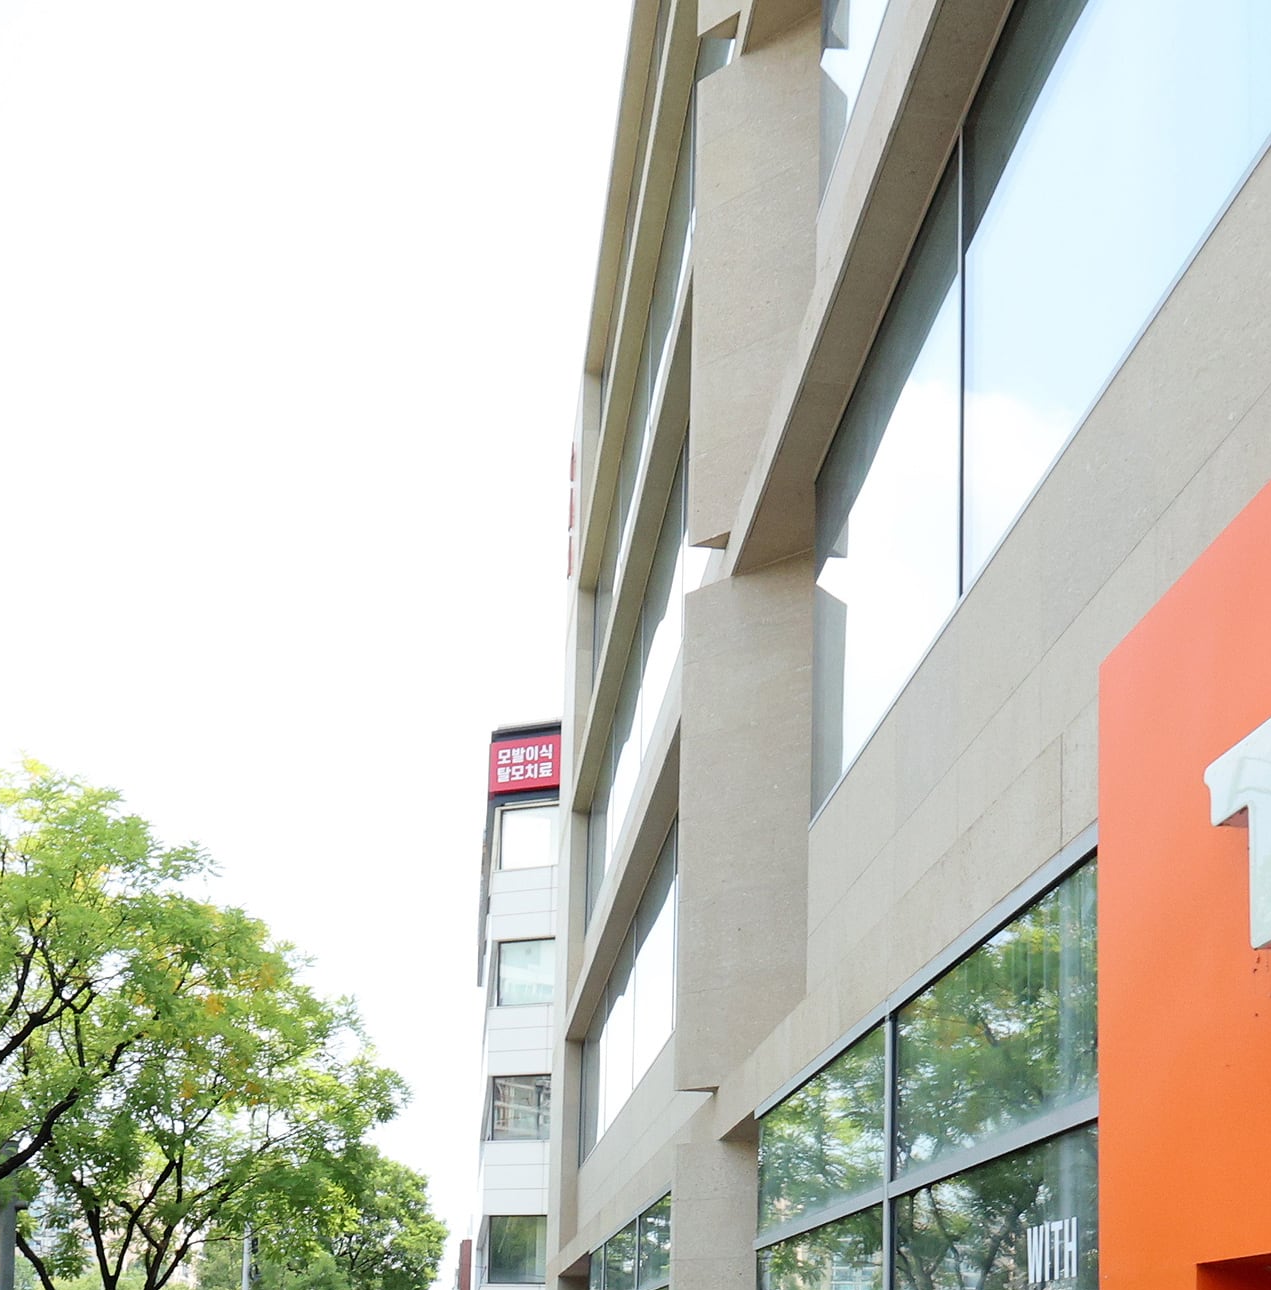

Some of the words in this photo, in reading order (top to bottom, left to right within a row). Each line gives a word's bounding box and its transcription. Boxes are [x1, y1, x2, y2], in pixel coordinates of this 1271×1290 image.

[497, 744, 553, 765] 모발이식
[497, 762, 553, 783] 탈모치료
[1027, 1216, 1077, 1285] WITH
